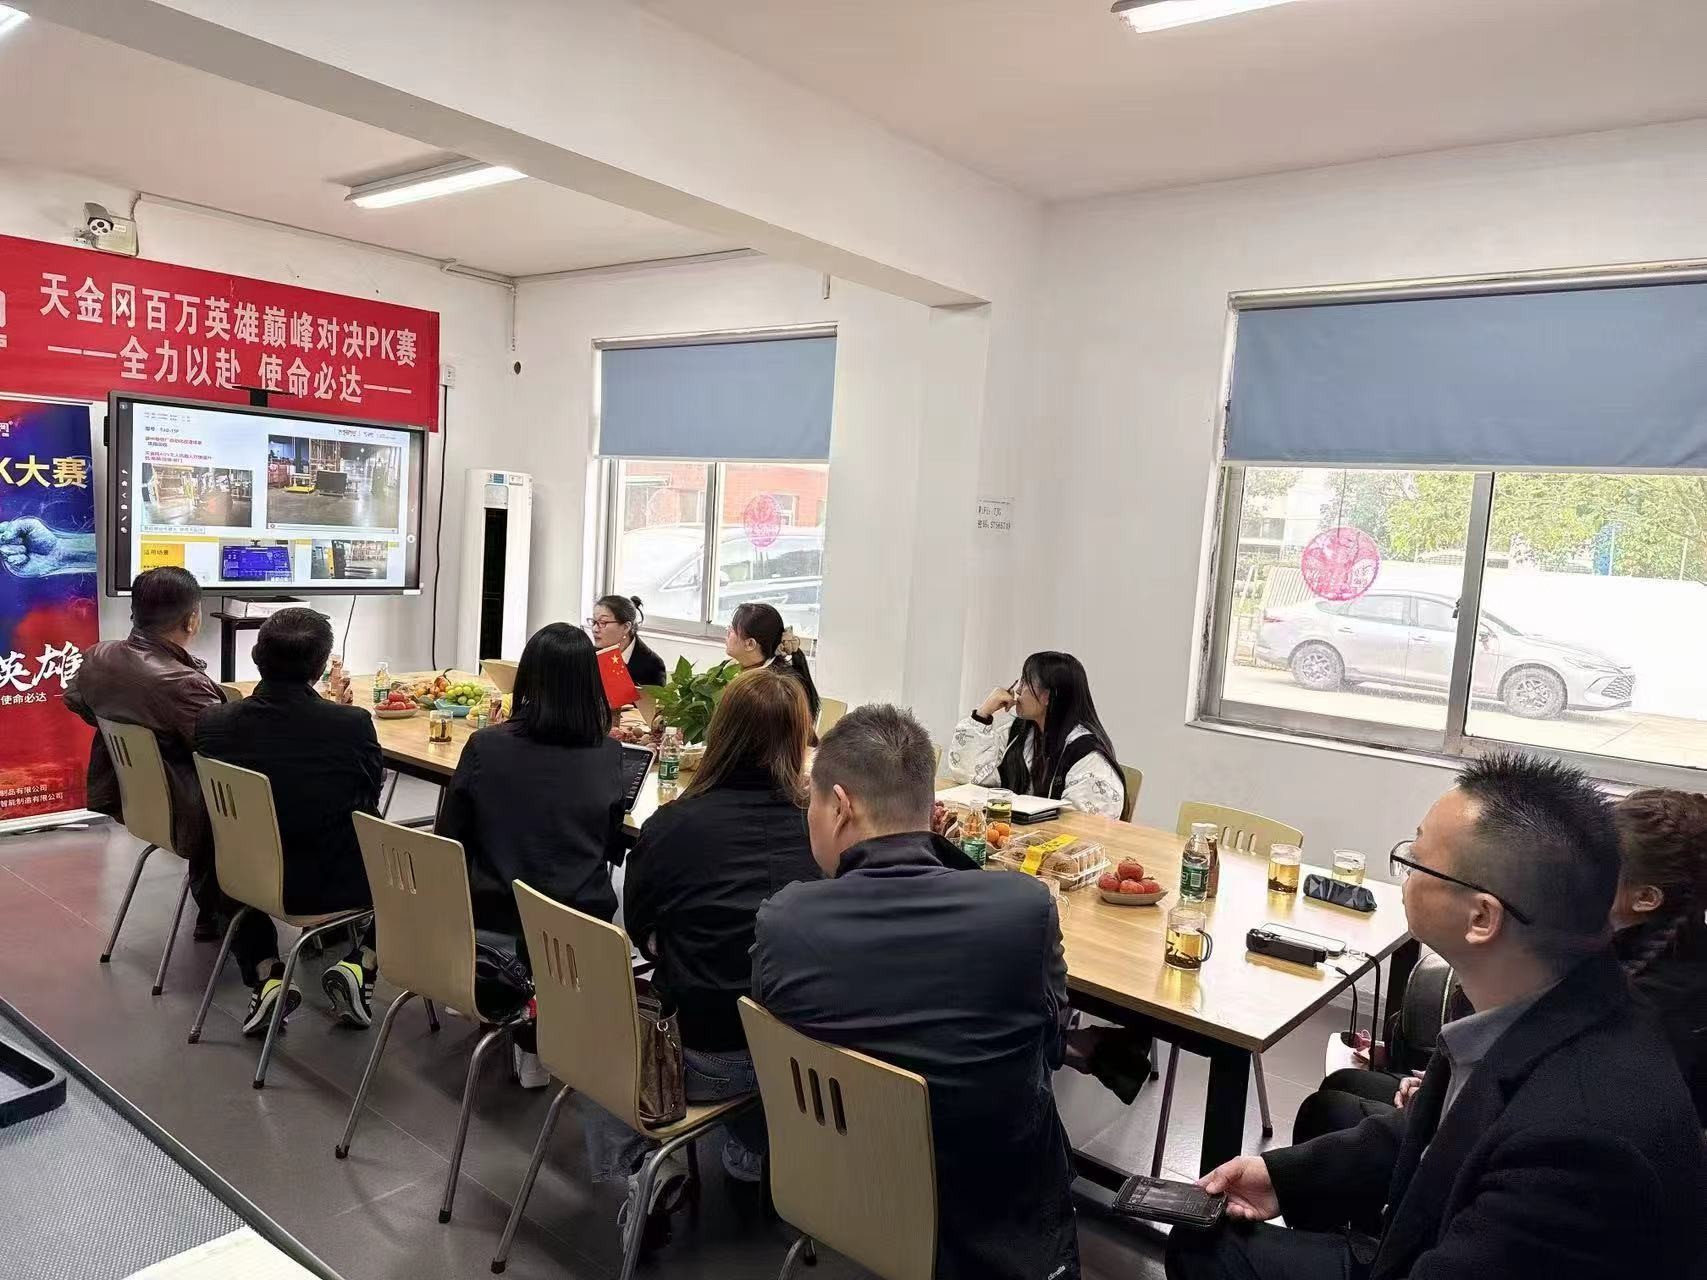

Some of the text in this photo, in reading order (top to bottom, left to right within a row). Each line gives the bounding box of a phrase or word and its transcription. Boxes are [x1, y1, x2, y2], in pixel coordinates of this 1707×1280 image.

[40, 272, 417, 367] 天金冈百万英雄巅峰对决PK赛
